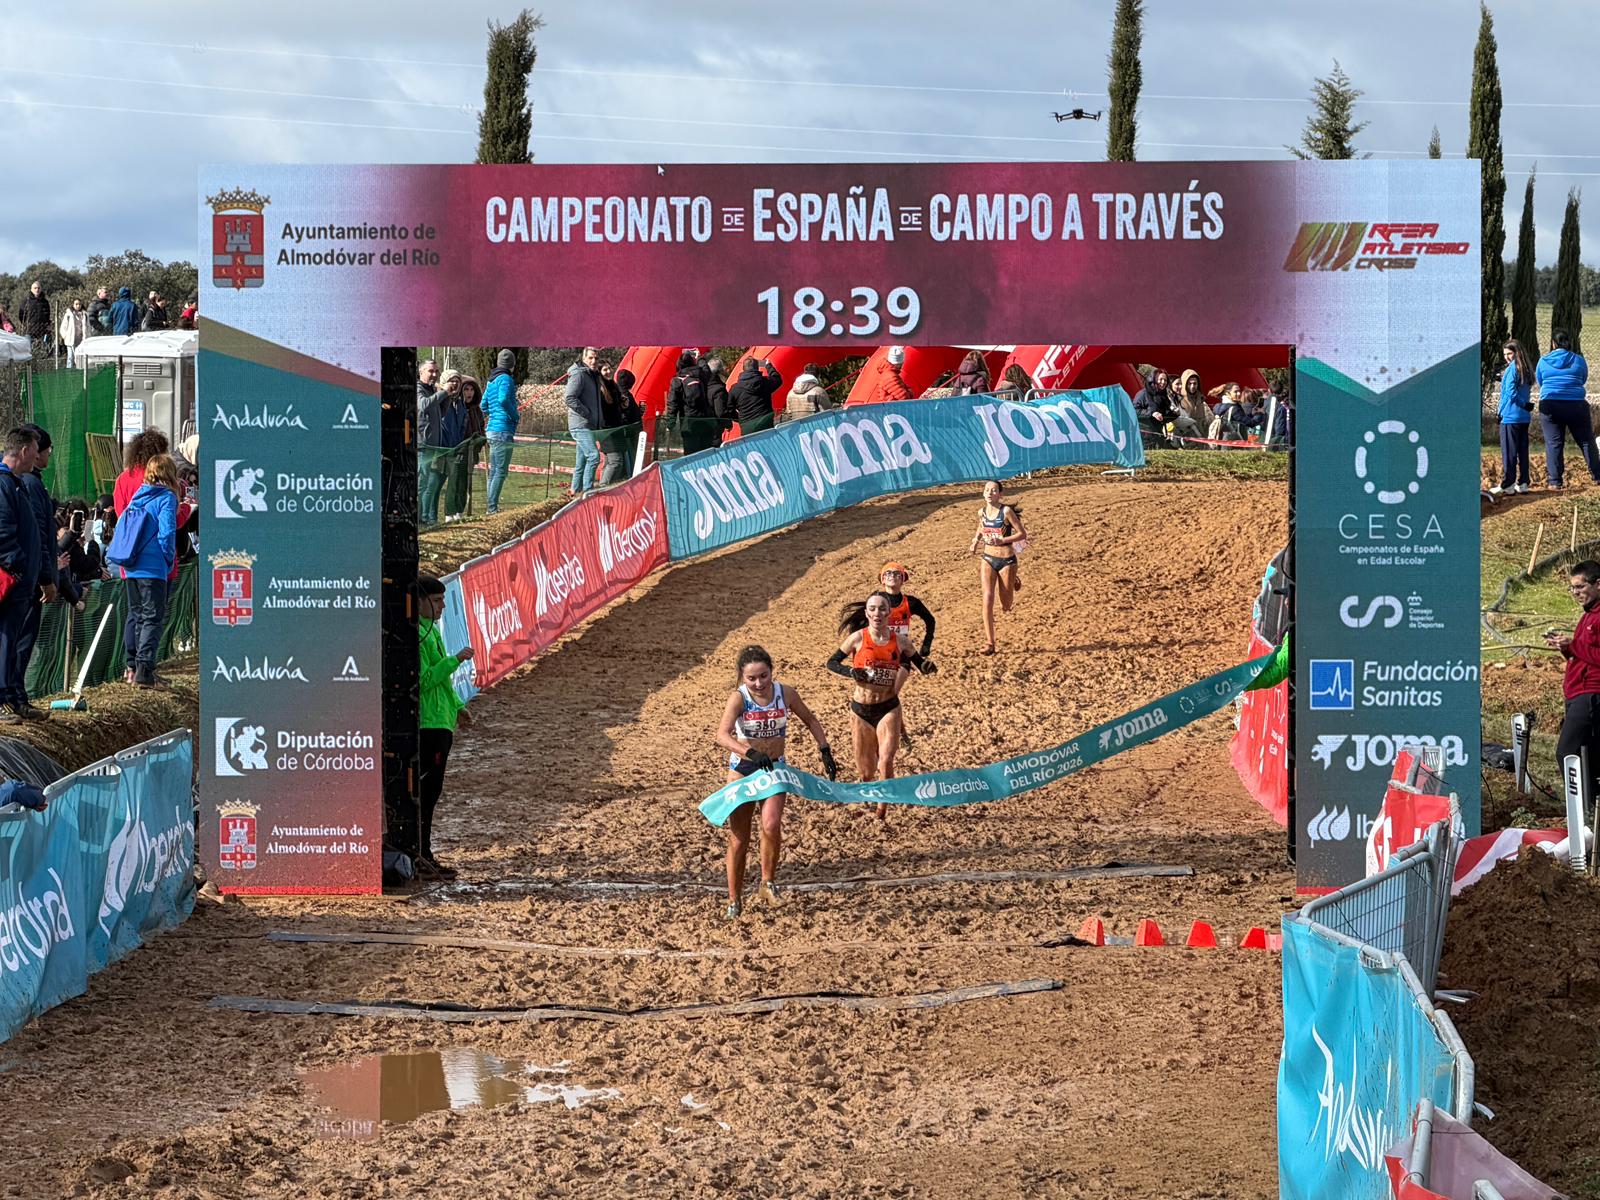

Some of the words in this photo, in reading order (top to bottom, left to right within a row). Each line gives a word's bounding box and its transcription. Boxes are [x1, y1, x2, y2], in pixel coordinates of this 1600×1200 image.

[485, 195, 713, 244] CAMPEONATO
[722, 213, 745, 226] DE
[753, 185, 895, 243] ESPAÑA
[900, 212, 922, 226] DE
[929, 192, 1053, 242] CAMPO
[1061, 193, 1084, 241] A
[1092, 180, 1224, 241] TRAVÉS
[281, 222, 409, 243] Ayuntamiento
[413, 223, 436, 240] de
[1368, 223, 1439, 242] RFEA
[277, 248, 374, 266] Almodóvar
[380, 248, 407, 266] del
[412, 248, 440, 266] Río
[1361, 242, 1470, 255] ATLETISMO
[1355, 257, 1418, 272] CROSS
[757, 286, 921, 336] 18:39
[211, 403, 309, 431] Andalucía
[276, 473, 373, 494] Diputación
[276, 496, 298, 513] de
[302, 495, 374, 513] Córdoba
[1338, 513, 1445, 540] CESA
[1338, 544, 1398, 555] Campeonatos
[1400, 544, 1412, 554] de
[1413, 544, 1445, 555] España
[1357, 557, 1368, 565] en
[1370, 556, 1393, 565] Edad
[1394, 556, 1426, 565] Escolar
[268, 576, 353, 593] Ayuntamiento
[355, 576, 371, 590] de
[262, 595, 331, 609] Almodóvar
[333, 595, 352, 609] del
[354, 595, 377, 609] Río
[212, 655, 310, 683] Andalucía
[1362, 659, 1479, 682] Fundación
[1361, 686, 1443, 707] Sanitas
[276, 731, 374, 752] Diputación
[276, 754, 298, 770] de
[303, 753, 374, 770] Córdoba
[1003, 742, 1080, 777] ALMODÓVAR
[1009, 775, 1032, 790] DEL
[1033, 765, 1056, 784] RÍO
[1056, 756, 1084, 775] 2026
[1568, 767, 1578, 796] UFO
[938, 777, 990, 796] Iberdrola
[270, 824, 348, 839] Ayuntamiento
[350, 824, 364, 837] de
[265, 841, 327, 854] Almodóvar
[329, 841, 347, 854] del
[349, 841, 369, 854] Río
